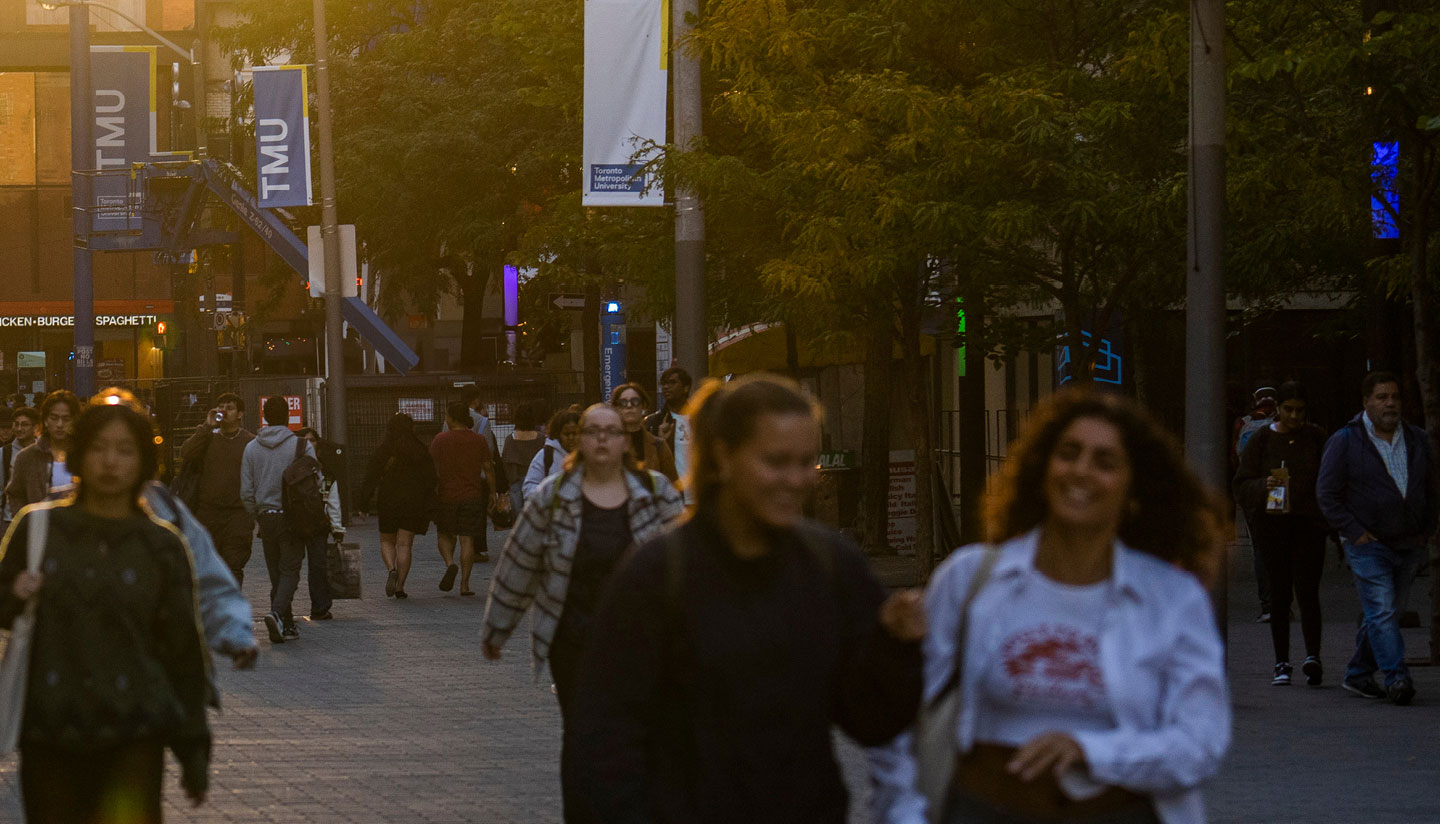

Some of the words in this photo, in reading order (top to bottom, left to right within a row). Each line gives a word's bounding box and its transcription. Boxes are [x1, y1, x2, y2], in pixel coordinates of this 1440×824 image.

[96, 89, 126, 174] TMU
[260, 119, 290, 199] TMU
[594, 167, 623, 175] Toronto
[594, 182, 632, 191] University
[37, 316, 75, 326] BURGE
[95, 315, 157, 326] SPAGHETTI
